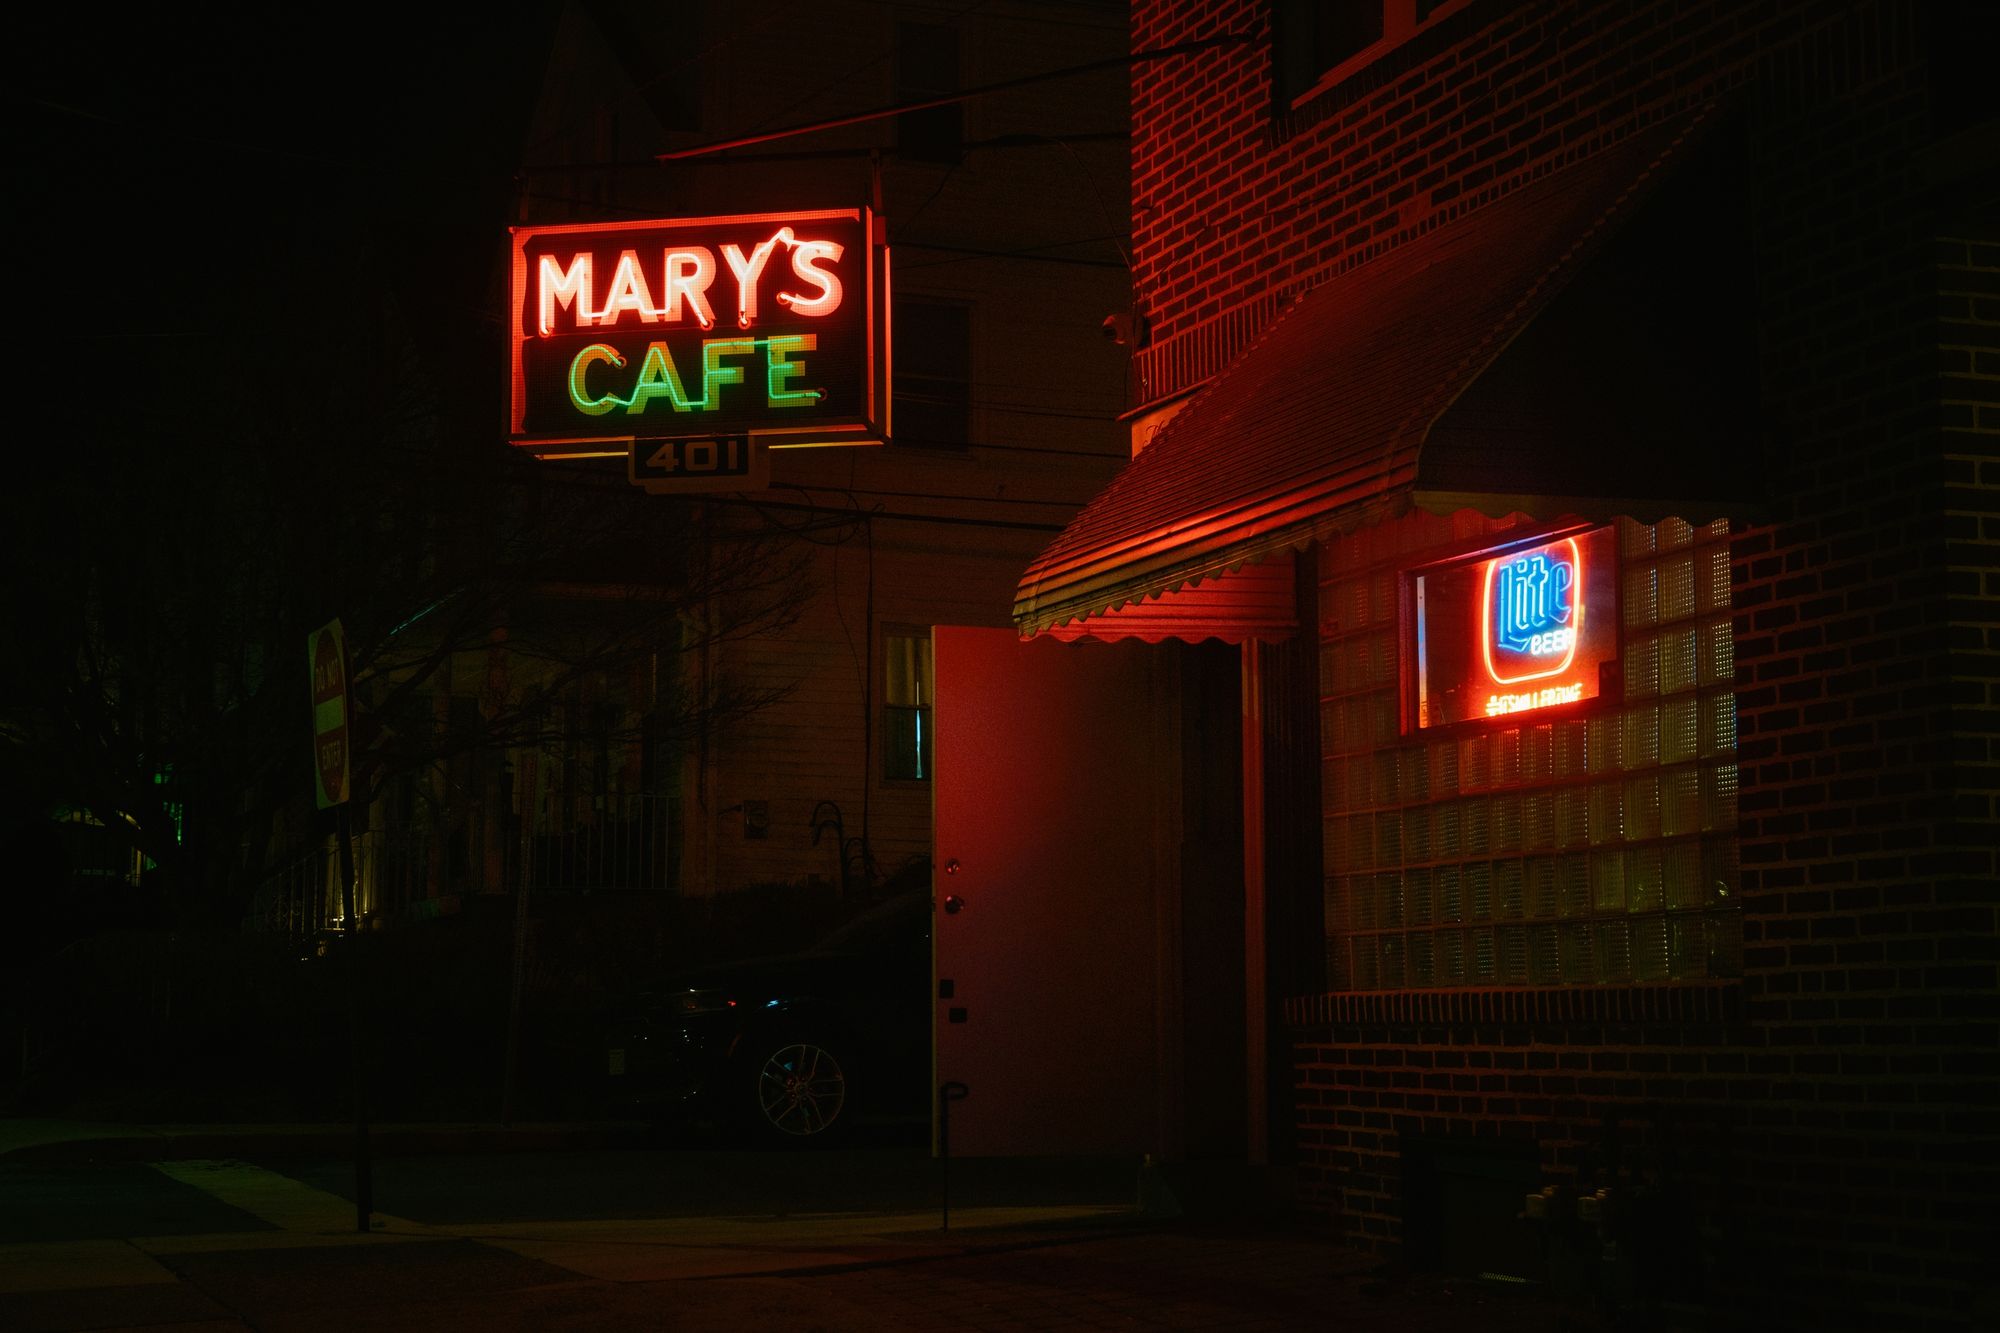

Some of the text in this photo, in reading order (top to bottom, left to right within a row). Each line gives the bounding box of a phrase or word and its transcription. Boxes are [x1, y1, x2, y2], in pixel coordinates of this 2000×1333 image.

[539, 227, 845, 331] MARY'S
[568, 333, 818, 416] CAFE
[645, 440, 738, 472] 401
[315, 657, 339, 693] DO NOT
[321, 739, 342, 770] ENTER
